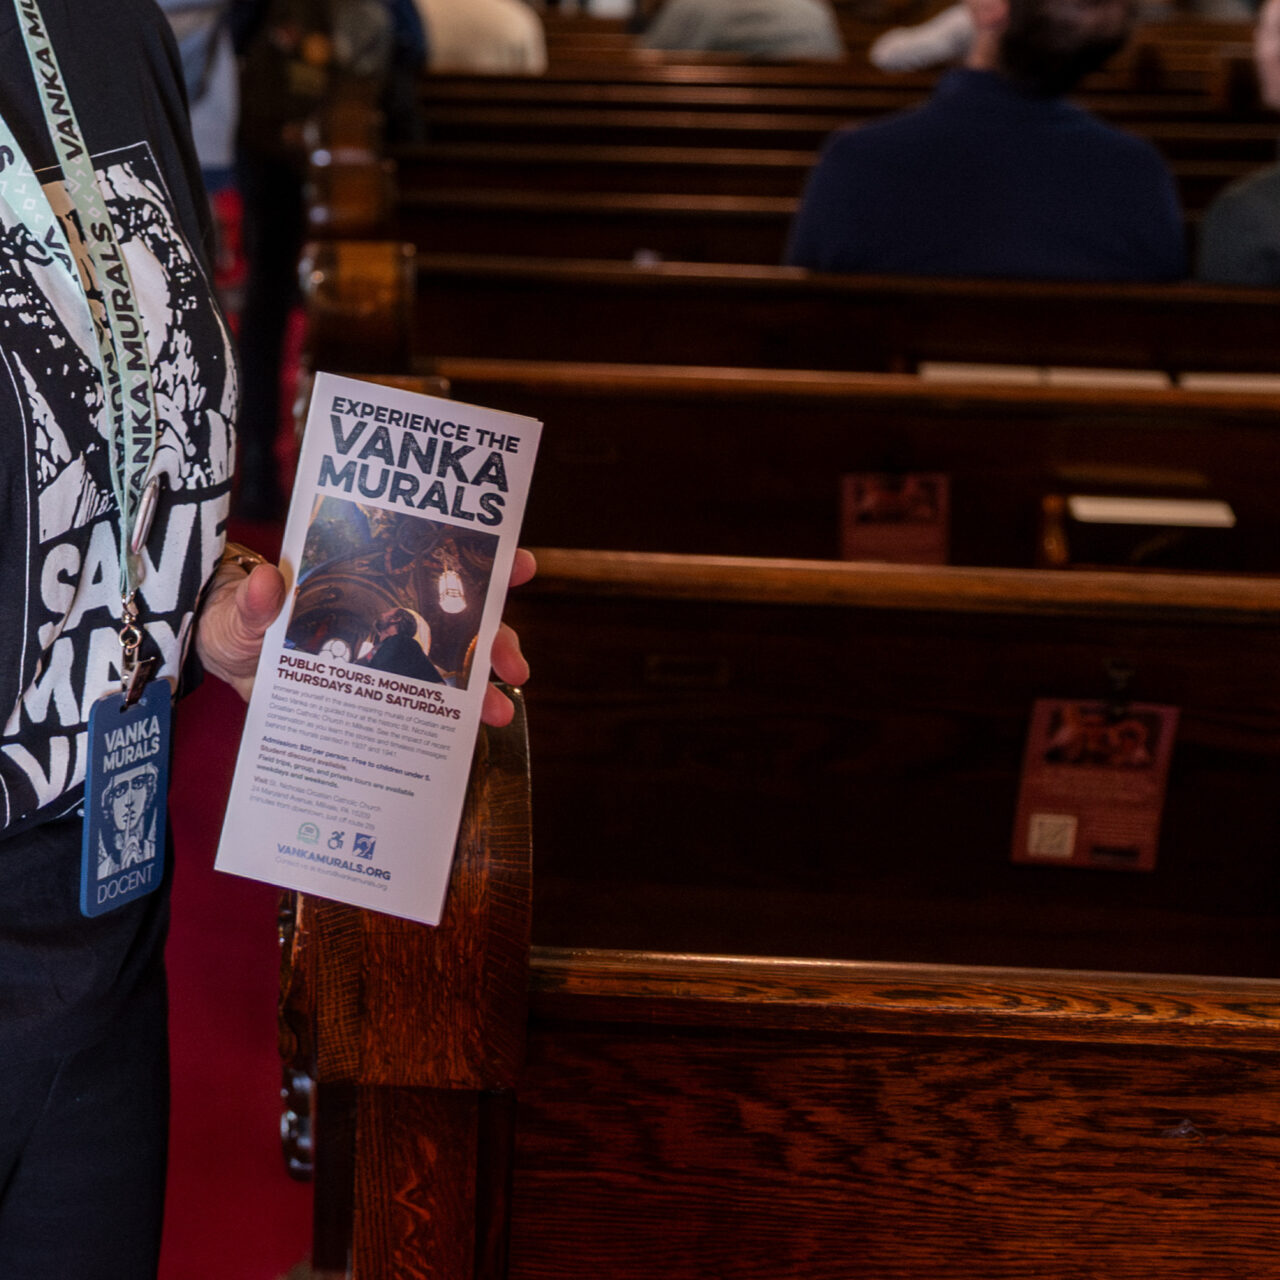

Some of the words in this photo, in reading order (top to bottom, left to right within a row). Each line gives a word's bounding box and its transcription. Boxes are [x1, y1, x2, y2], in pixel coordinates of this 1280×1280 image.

[34, 46, 84, 161] VANKA
[91, 223, 148, 371] MURALS
[126, 380, 153, 517] VANKA
[331, 395, 470, 442] EXPERIENCE
[472, 427, 521, 453] THE
[330, 414, 509, 492] VANKA
[317, 454, 507, 528] MURALS
[276, 667, 352, 694] THURSDAYS
[354, 685, 383, 701] AND
[385, 692, 461, 720] SATURDAYS
[279, 654, 325, 674] PUBLIC
[327, 665, 375, 685] TOURS:
[377, 677, 445, 703] MONDAYS,
[102, 736, 160, 773] MURALS
[104, 715, 160, 753] VANKA
[262, 735, 298, 748] Admission:
[351, 756, 366, 765] Free
[376, 762, 402, 774] children
[404, 769, 423, 779] under
[97, 863, 155, 904] DOCENT
[276, 843, 391, 880] VANKAMURALS.ORG
